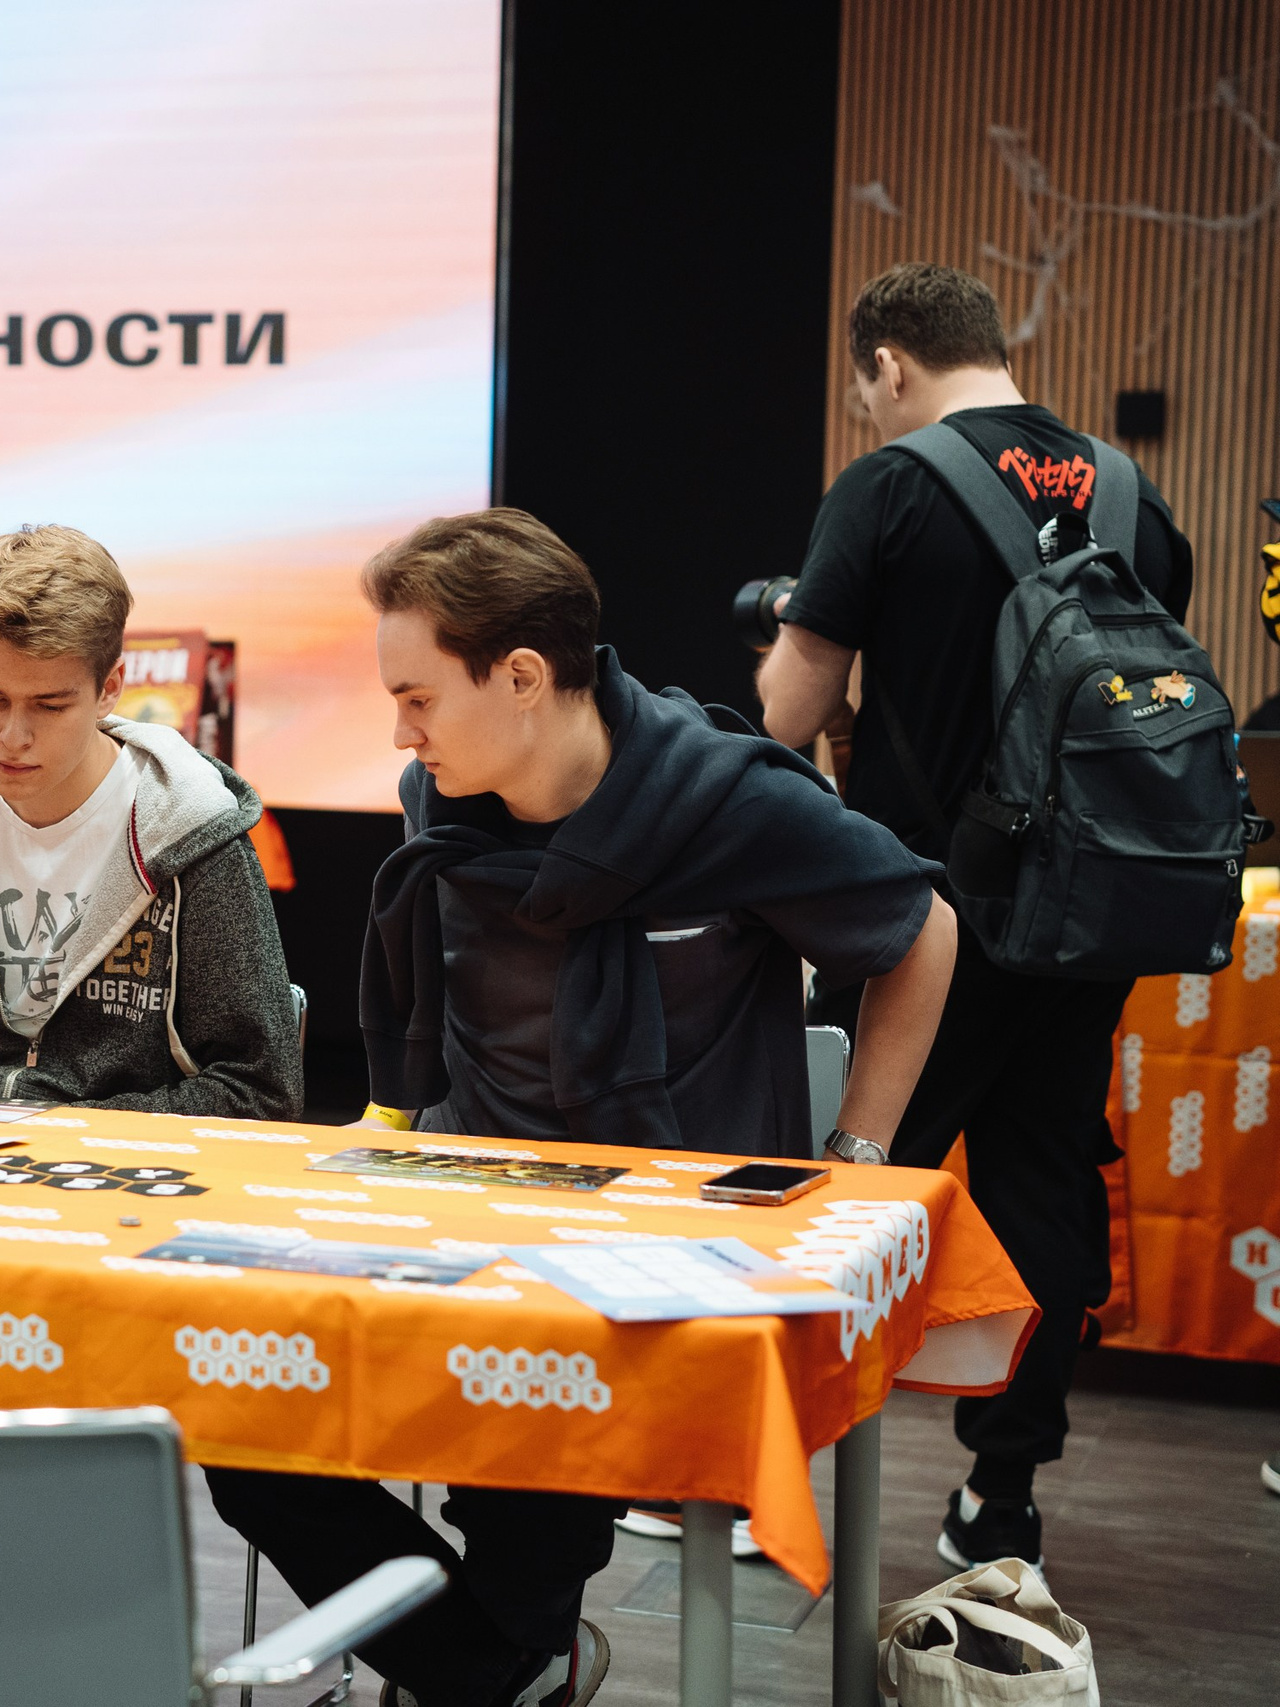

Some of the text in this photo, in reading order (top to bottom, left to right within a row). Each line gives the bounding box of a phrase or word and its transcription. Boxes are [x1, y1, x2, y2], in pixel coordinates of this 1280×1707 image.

[1043, 487, 1093, 498] ERSERK
[104, 930, 154, 978] 23
[102, 1002, 124, 1016] WIN
[182, 1333, 307, 1359] HOBBY
[195, 1358, 323, 1385] GAMES
[454, 1352, 588, 1378] HOBBY
[469, 1379, 603, 1405] GAMES
